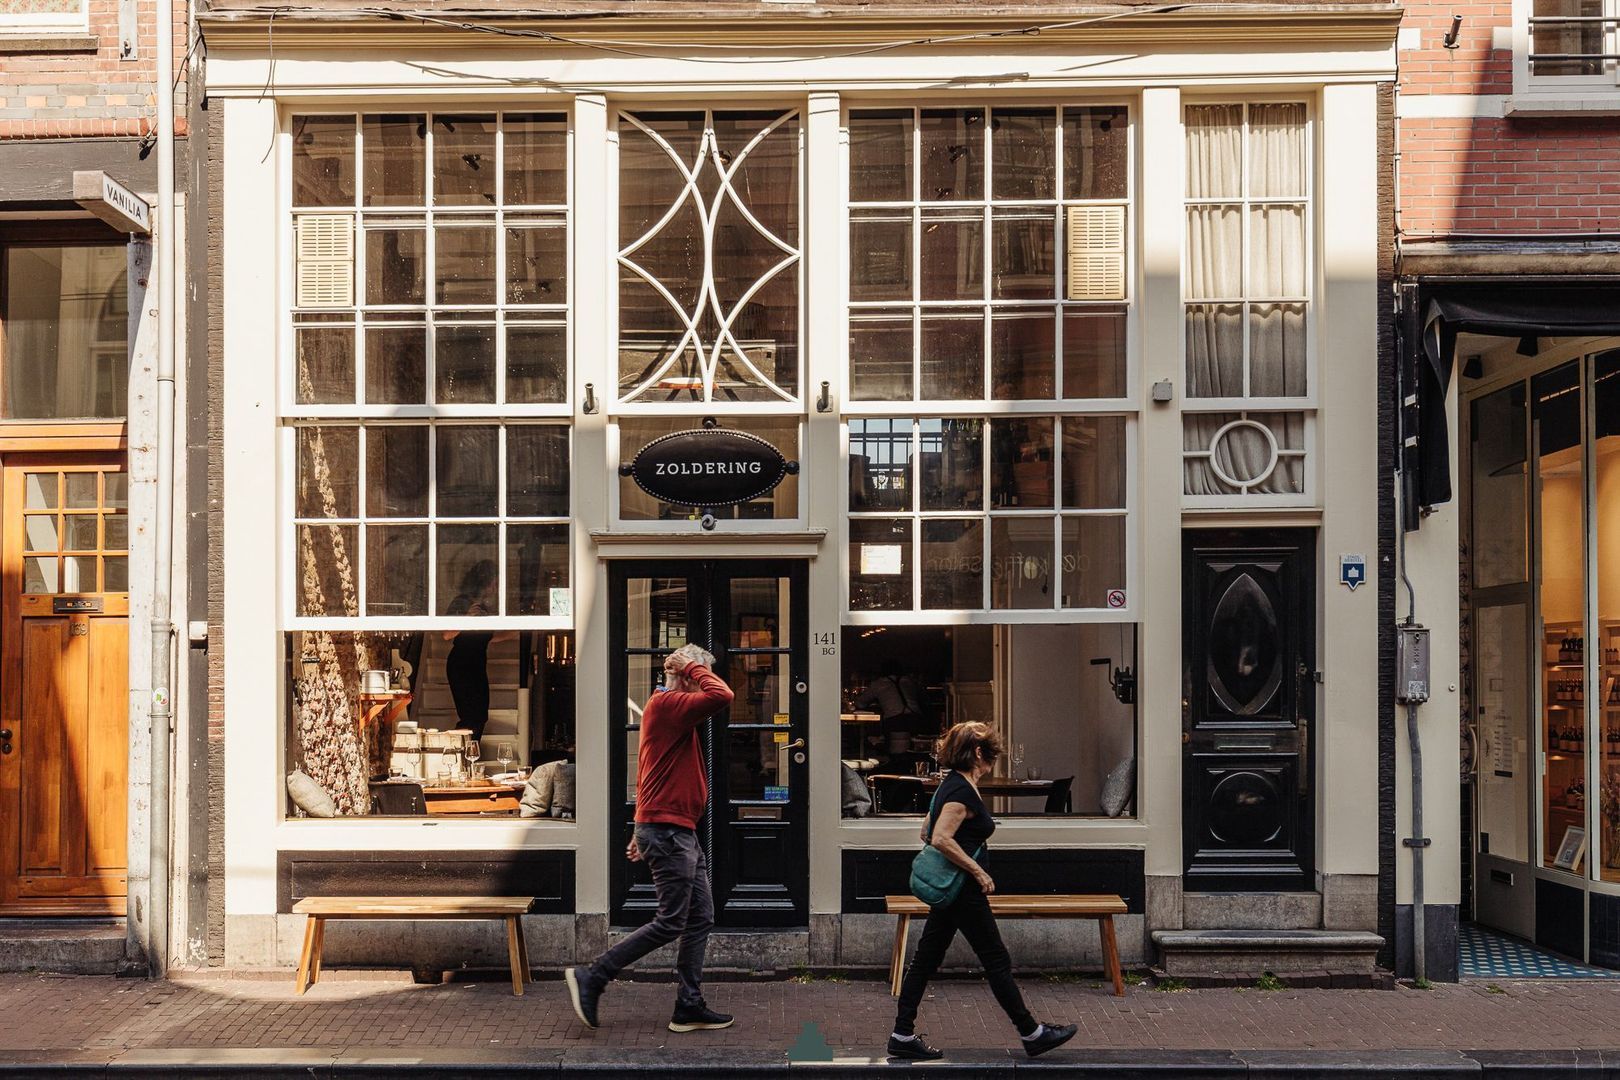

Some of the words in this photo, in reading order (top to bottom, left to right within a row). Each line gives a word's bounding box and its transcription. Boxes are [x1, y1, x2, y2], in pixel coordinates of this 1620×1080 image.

[106, 183, 142, 220] VANILIA
[655, 461, 762, 475] ZOLDERING
[813, 632, 836, 645] 141
[822, 647, 836, 656] BG
